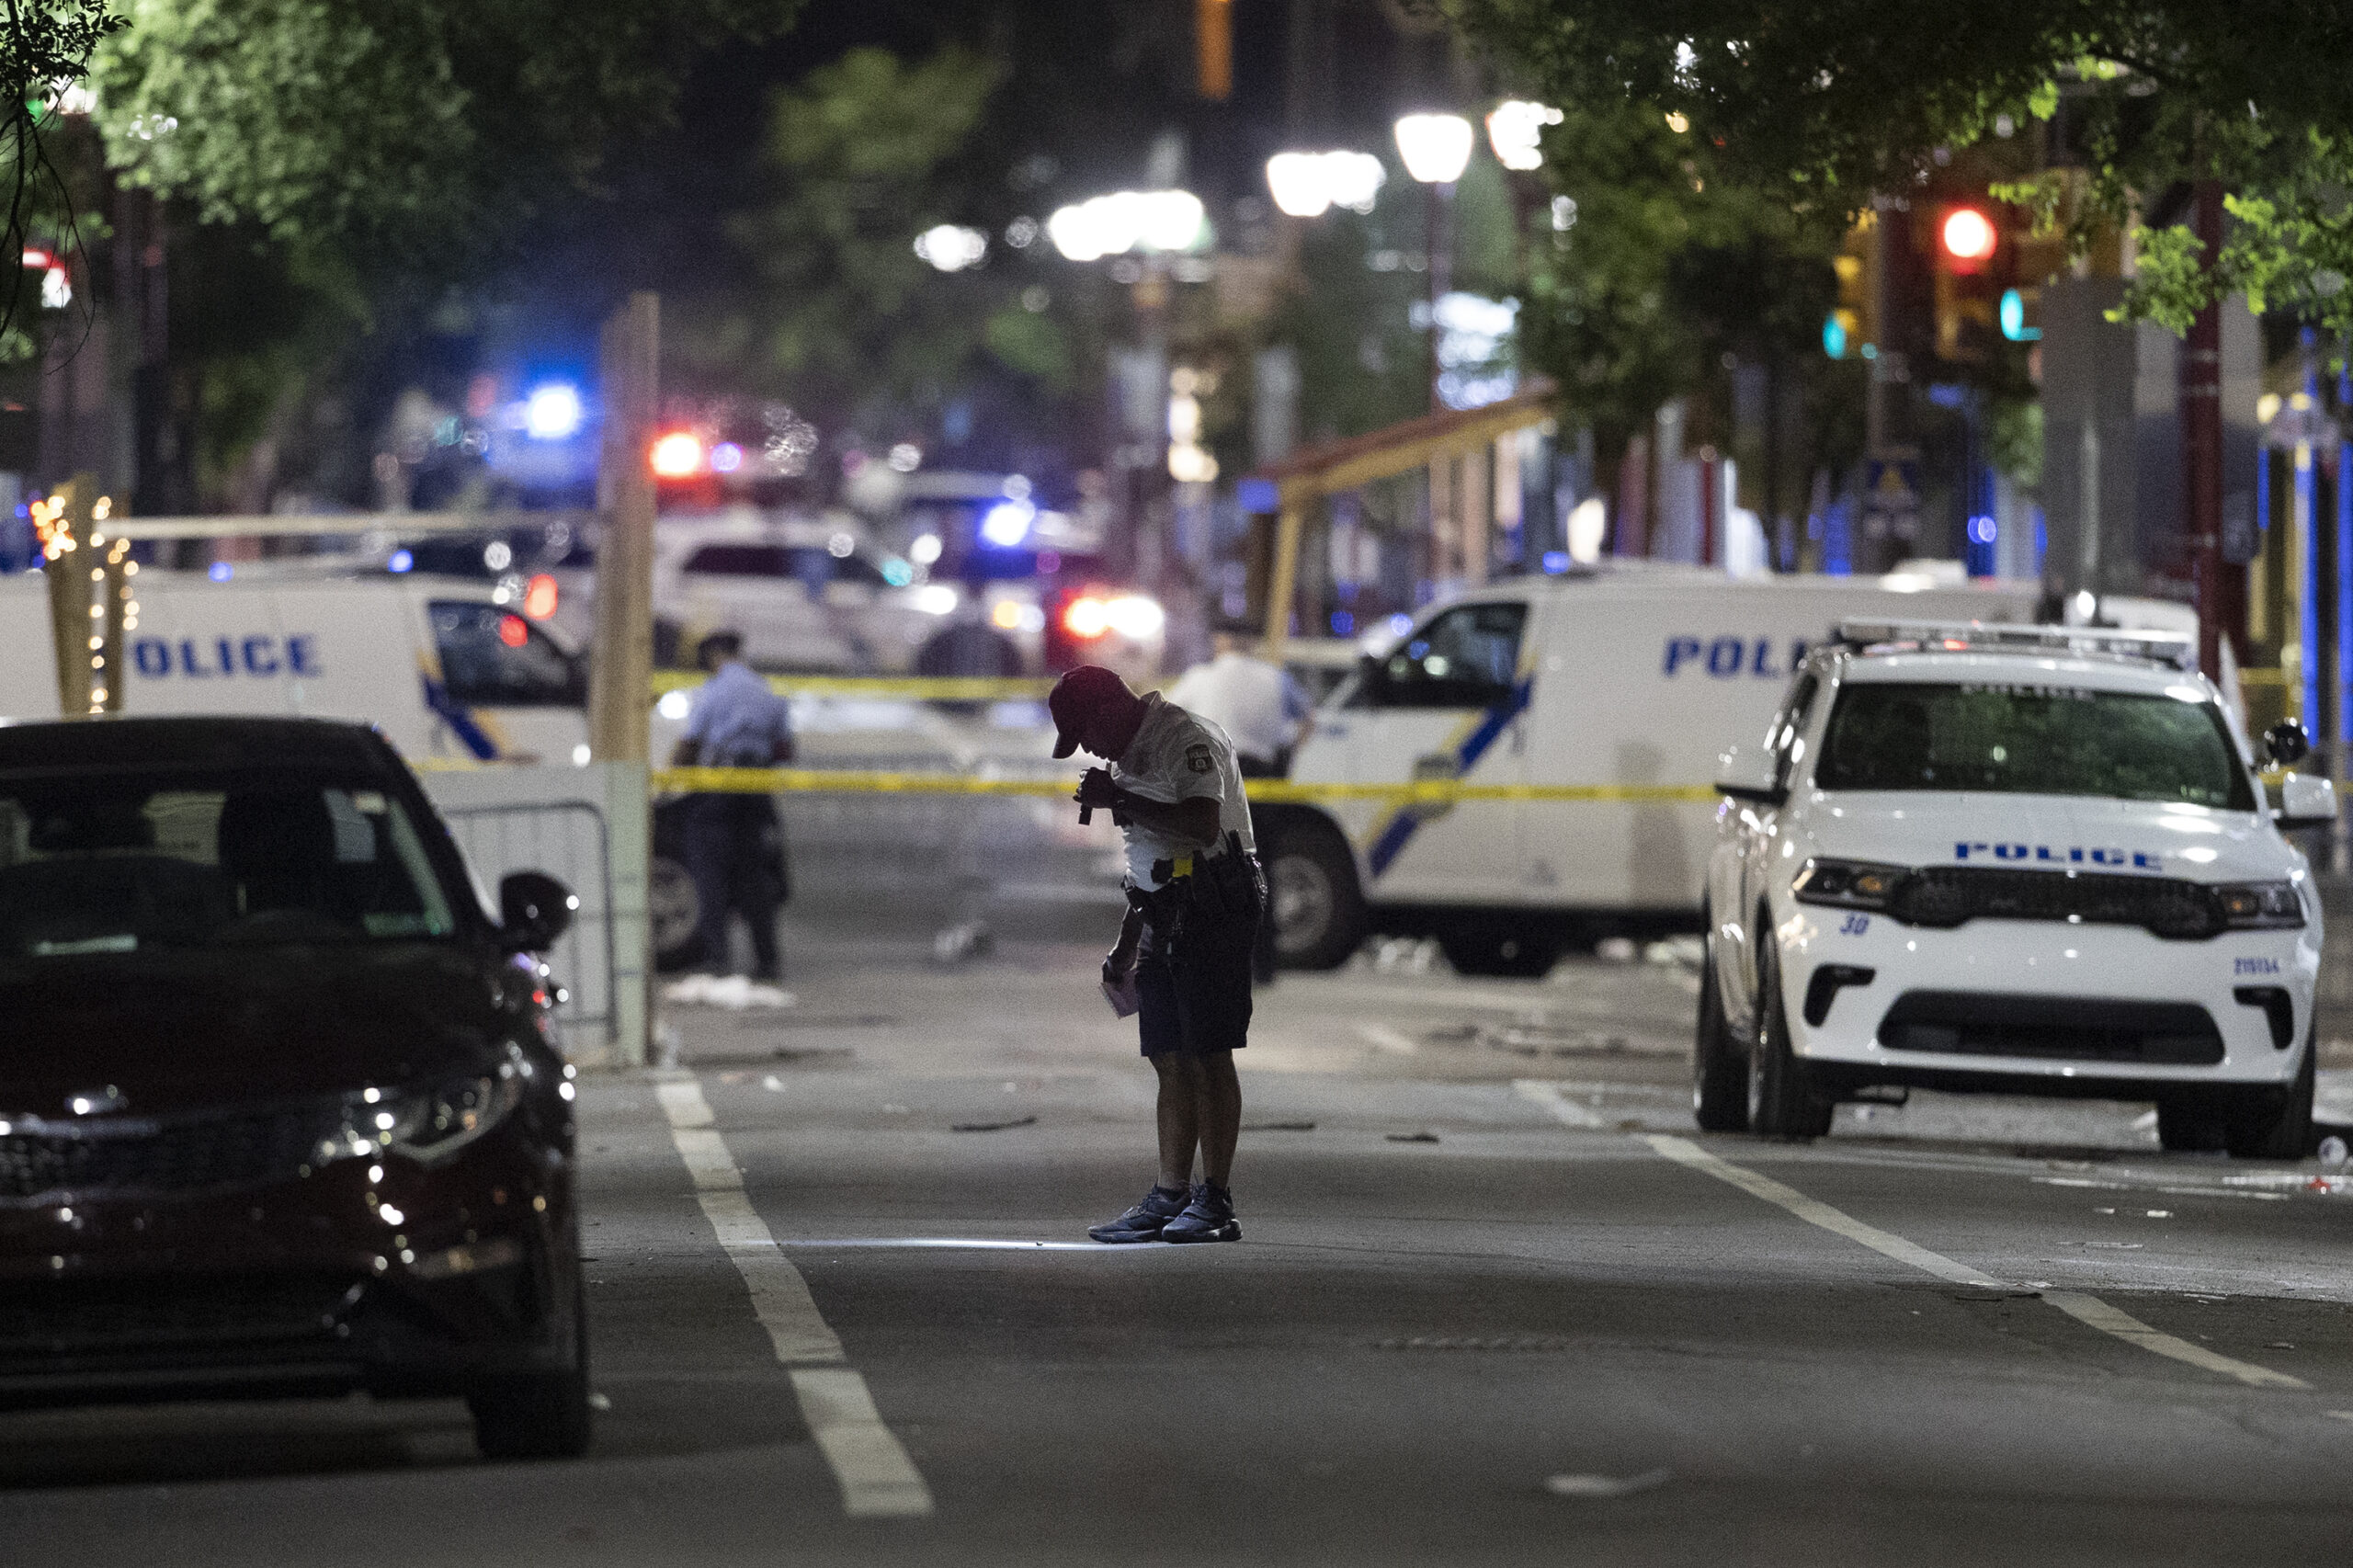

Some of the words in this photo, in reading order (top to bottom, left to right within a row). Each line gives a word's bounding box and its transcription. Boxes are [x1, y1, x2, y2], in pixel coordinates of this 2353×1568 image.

[96, 635, 324, 678] OLICE
[1663, 636, 1807, 677] POLI
[1955, 843, 2162, 870] POLICE
